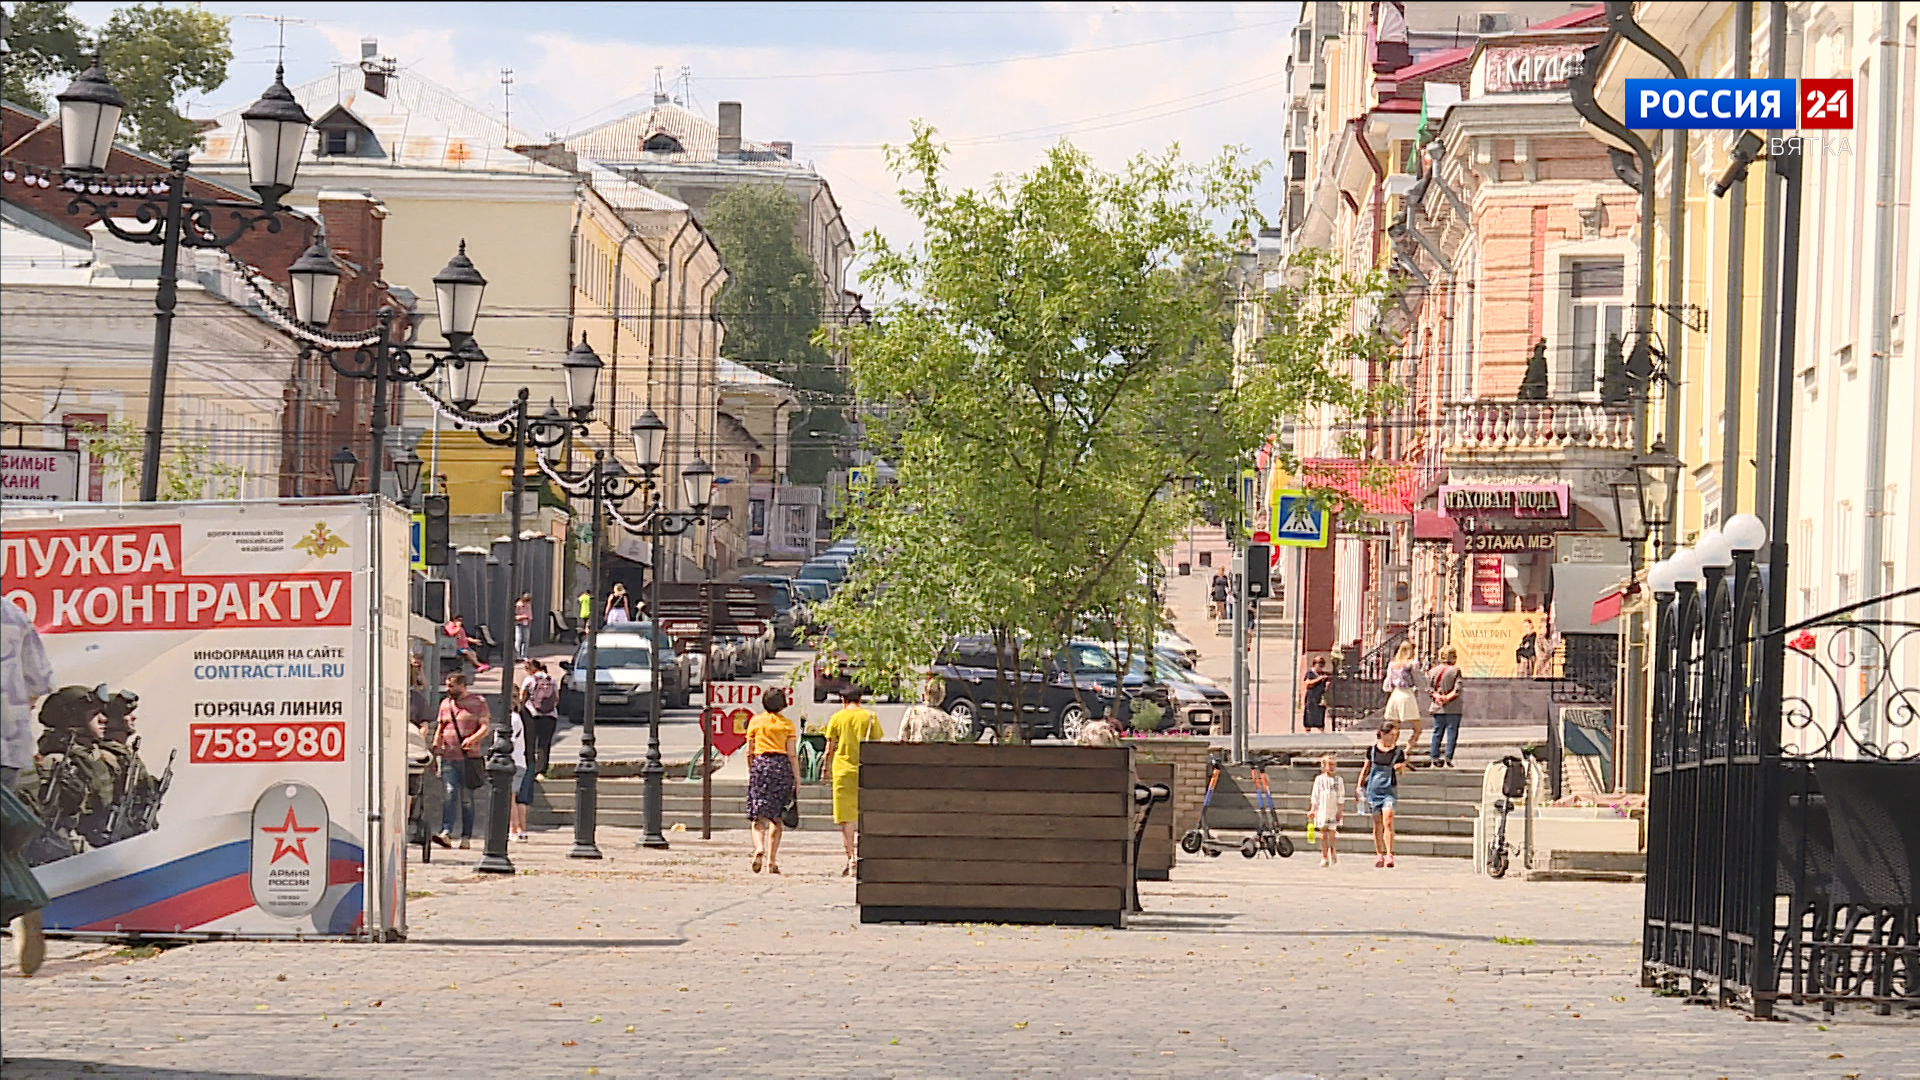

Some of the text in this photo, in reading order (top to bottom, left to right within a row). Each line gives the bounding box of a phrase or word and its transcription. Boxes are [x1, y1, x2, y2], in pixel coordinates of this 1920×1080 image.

[1517, 490, 1558, 512] МОДА
[1465, 535, 1473, 551] 2
[1476, 534, 1525, 550] ЭТАЖА
[0, 533, 174, 579] ЛУЖБА
[52, 579, 342, 627] КОНТРАКТУ
[194, 645, 345, 661] ИНФОРМАЦИЯ НА САЙТЕ
[194, 663, 345, 680] CONTRACT.MIL.RU
[710, 685, 794, 706] КИРВ
[195, 701, 342, 717] ГОРЯЧАЯ ЛИНИЯ
[194, 726, 342, 758] 758-980
